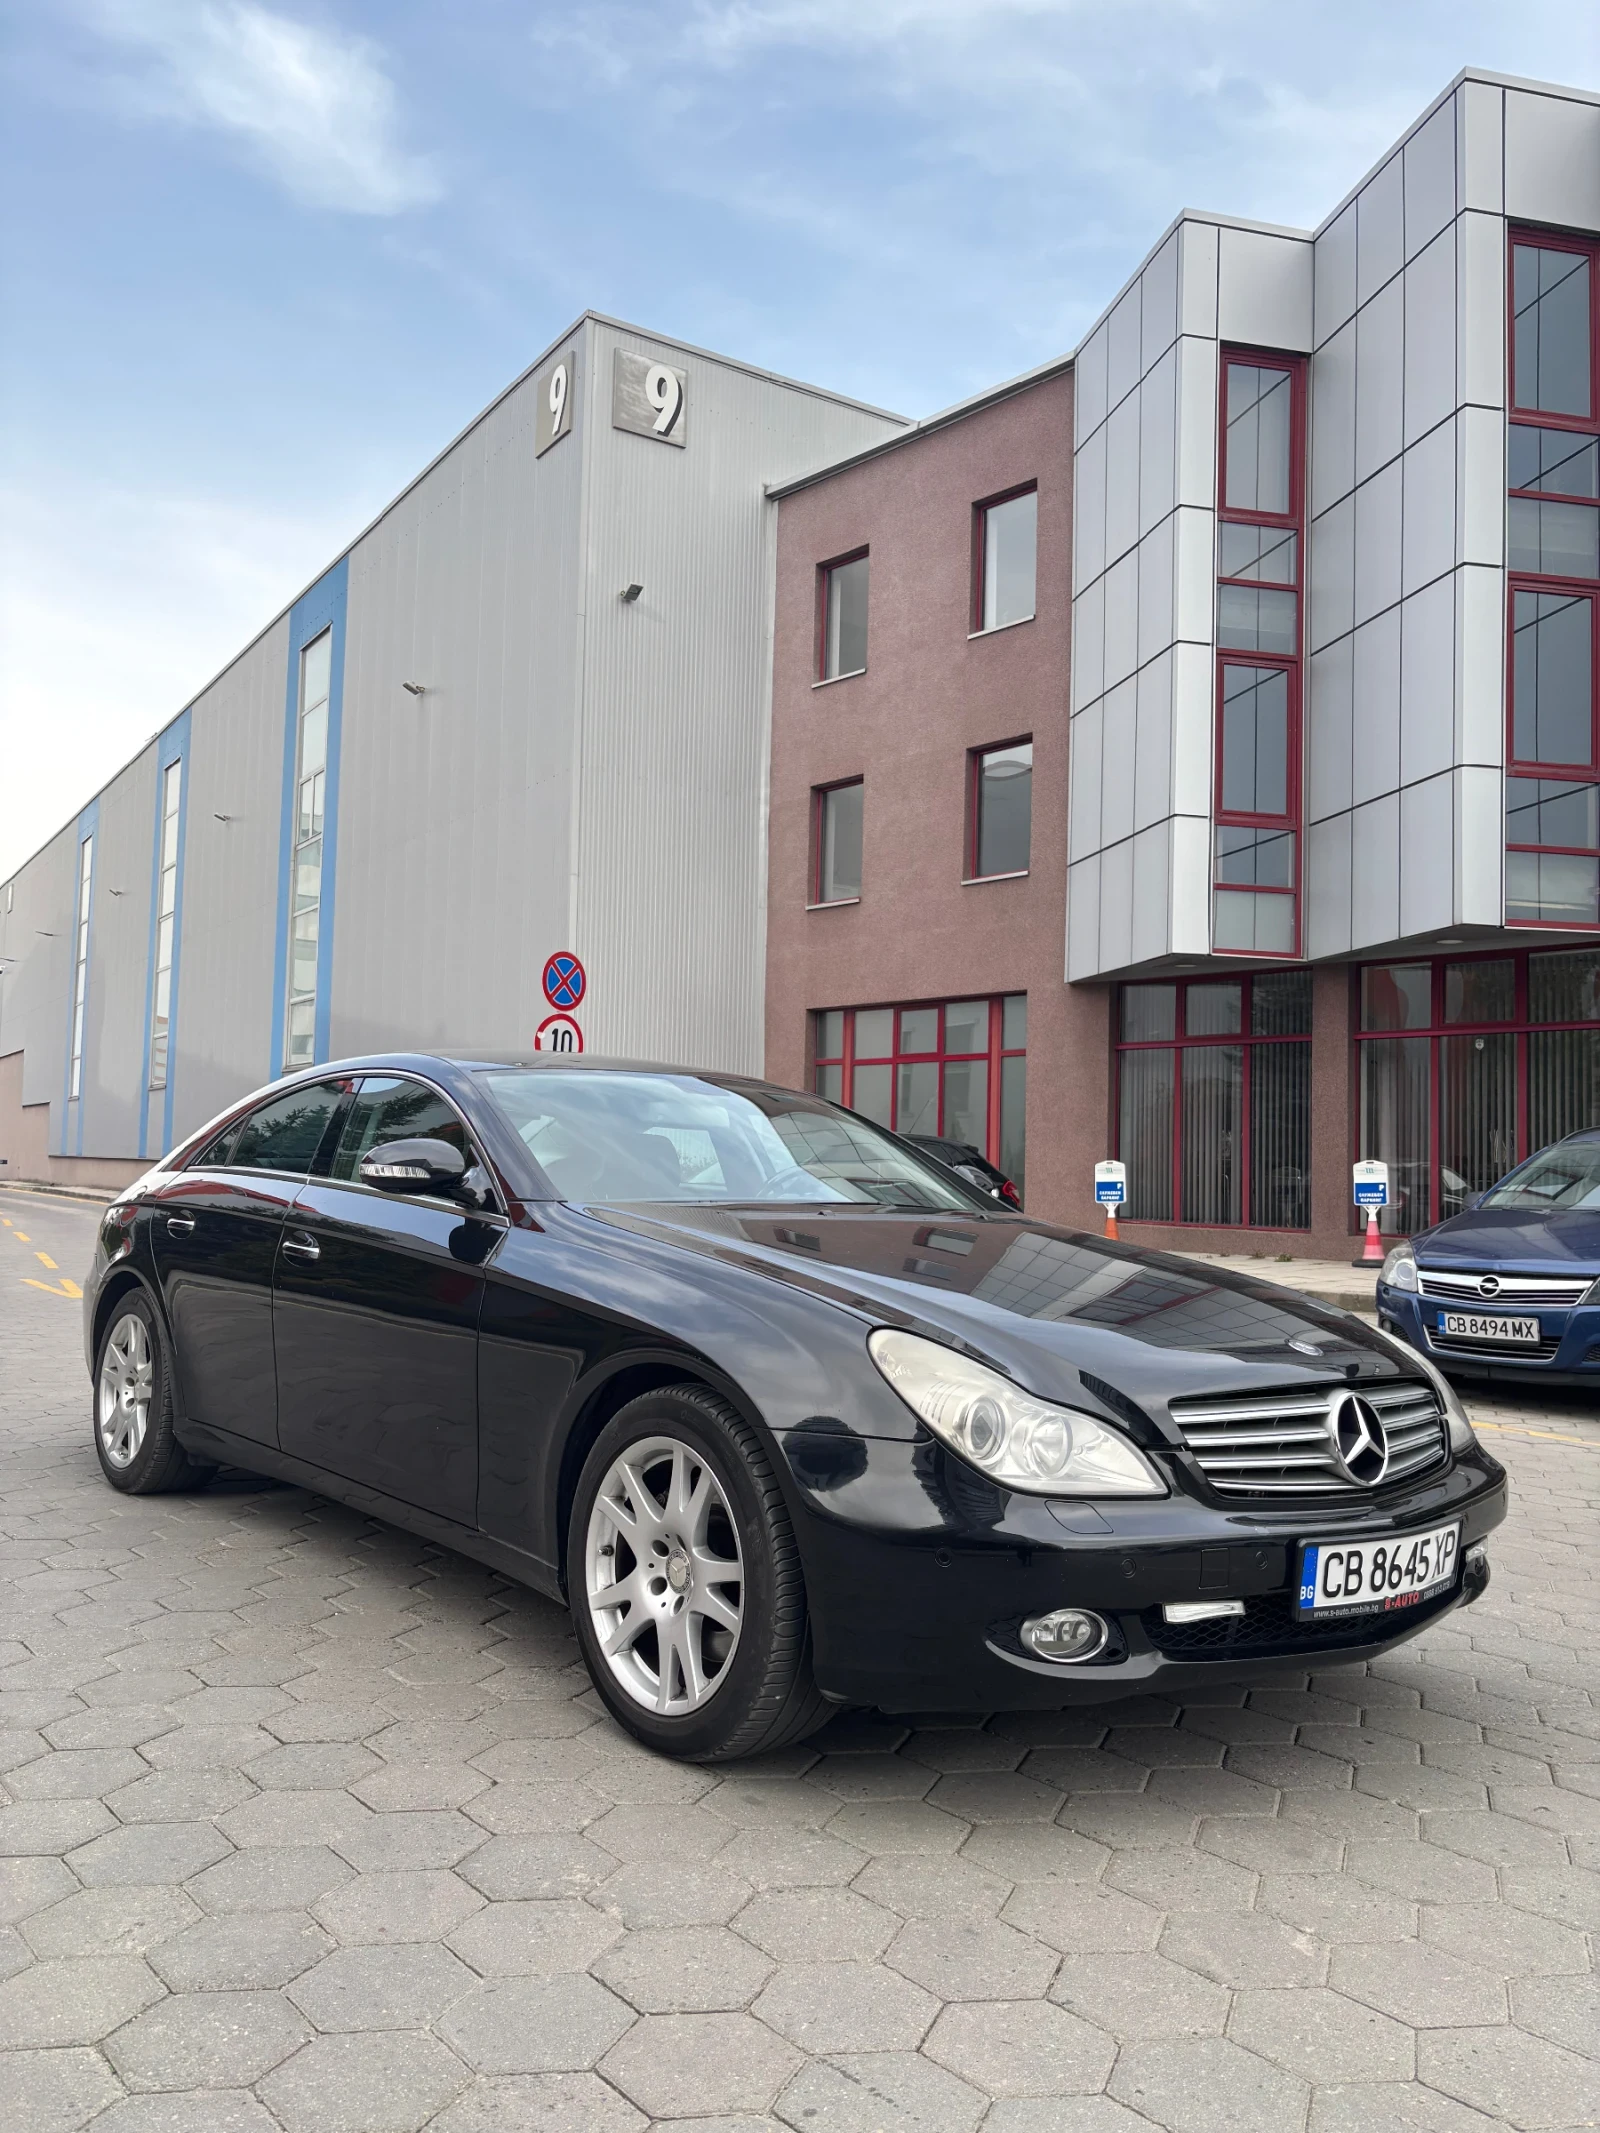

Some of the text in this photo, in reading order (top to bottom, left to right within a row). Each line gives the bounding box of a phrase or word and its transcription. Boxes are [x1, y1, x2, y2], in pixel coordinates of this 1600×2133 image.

[550, 364, 568, 436] 9
[646, 365, 681, 436] 9
[551, 1028, 573, 1052] 10
[1447, 1316, 1535, 1339] CB 8494 MX
[1322, 1529, 1456, 1598] CB 8645 XP
[1300, 1585, 1314, 1600] BG
[1384, 1591, 1420, 1610] S-AUTO
[1313, 1604, 1379, 1618] www.s-auto.mobile.bg
